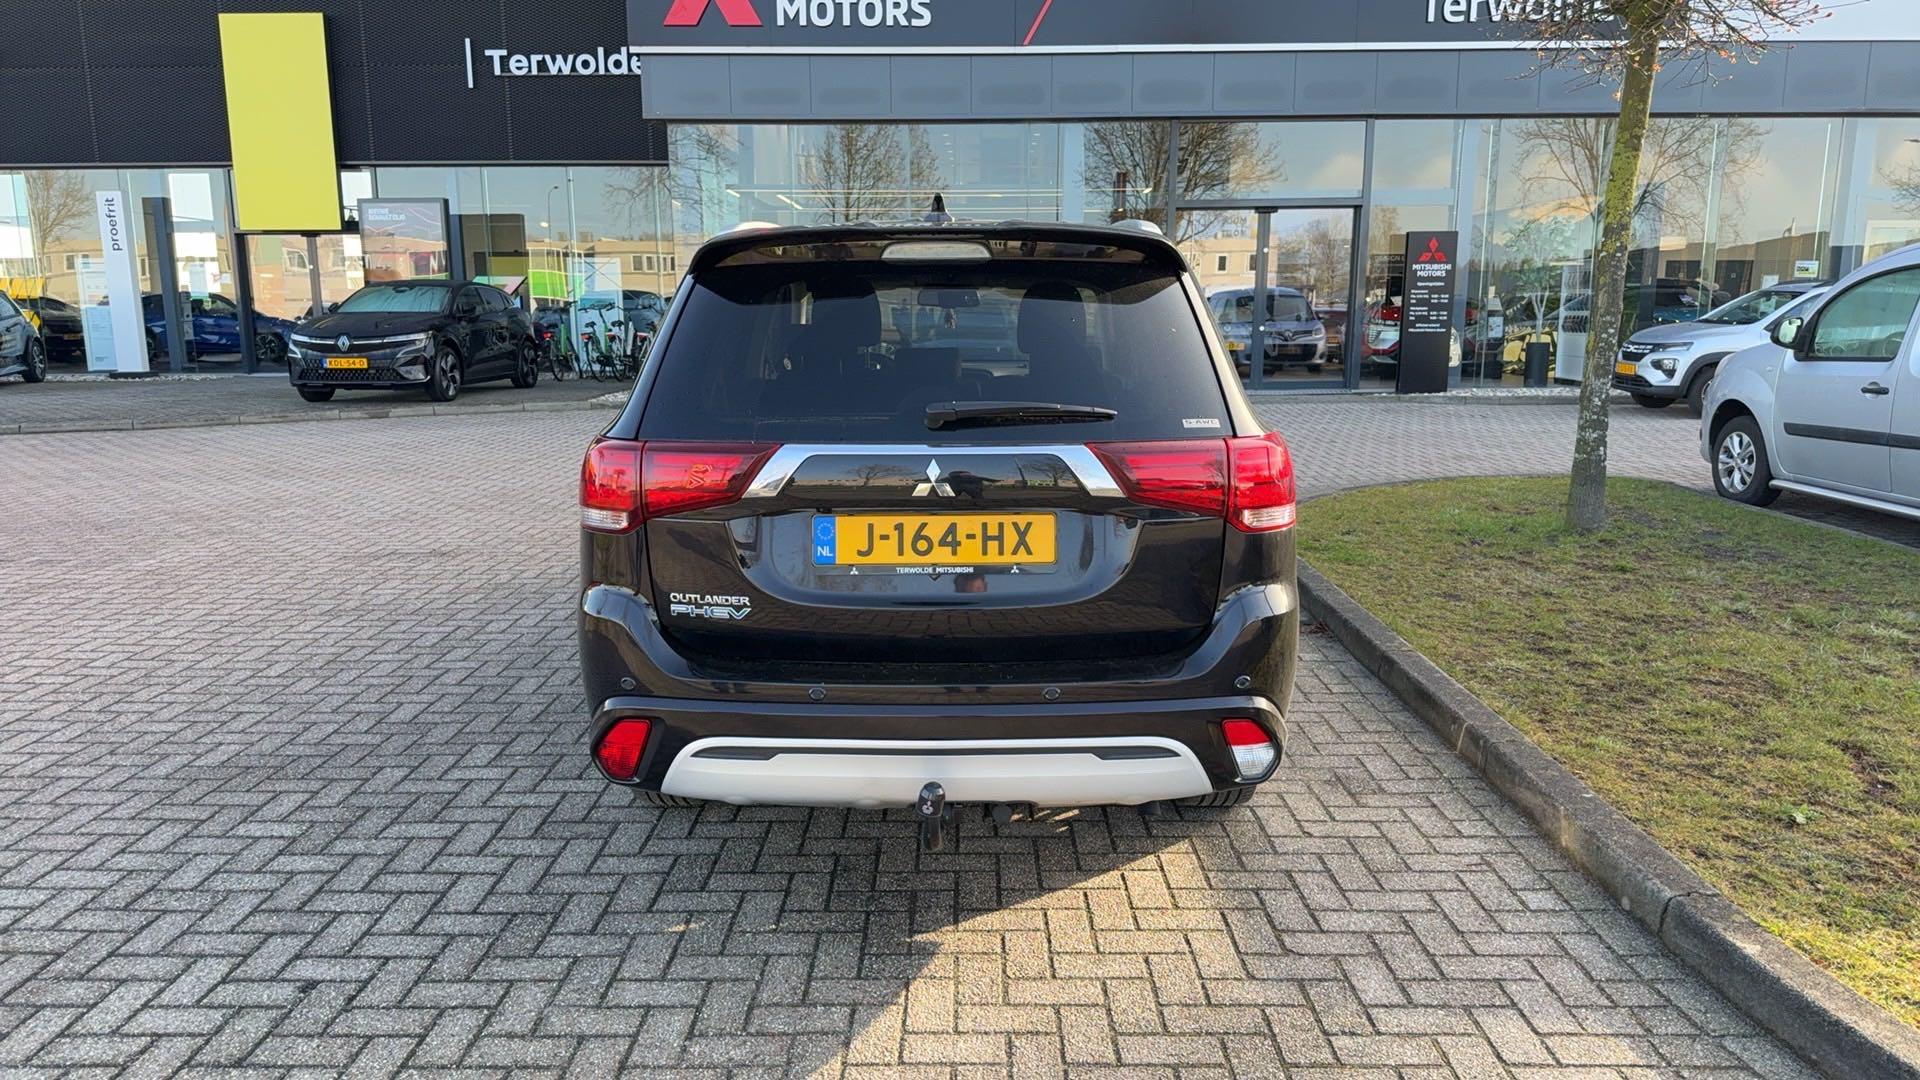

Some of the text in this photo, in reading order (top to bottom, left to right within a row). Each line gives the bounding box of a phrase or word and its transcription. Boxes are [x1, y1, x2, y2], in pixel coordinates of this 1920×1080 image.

[776, 0, 932, 27] MOTORS
[484, 46, 641, 76] Terwolde
[104, 197, 122, 251] proefrit
[817, 546, 833, 557] NL
[856, 521, 1033, 557] J-164-HX
[669, 592, 751, 606] OUTLANDER
[670, 603, 752, 620] PHEV
